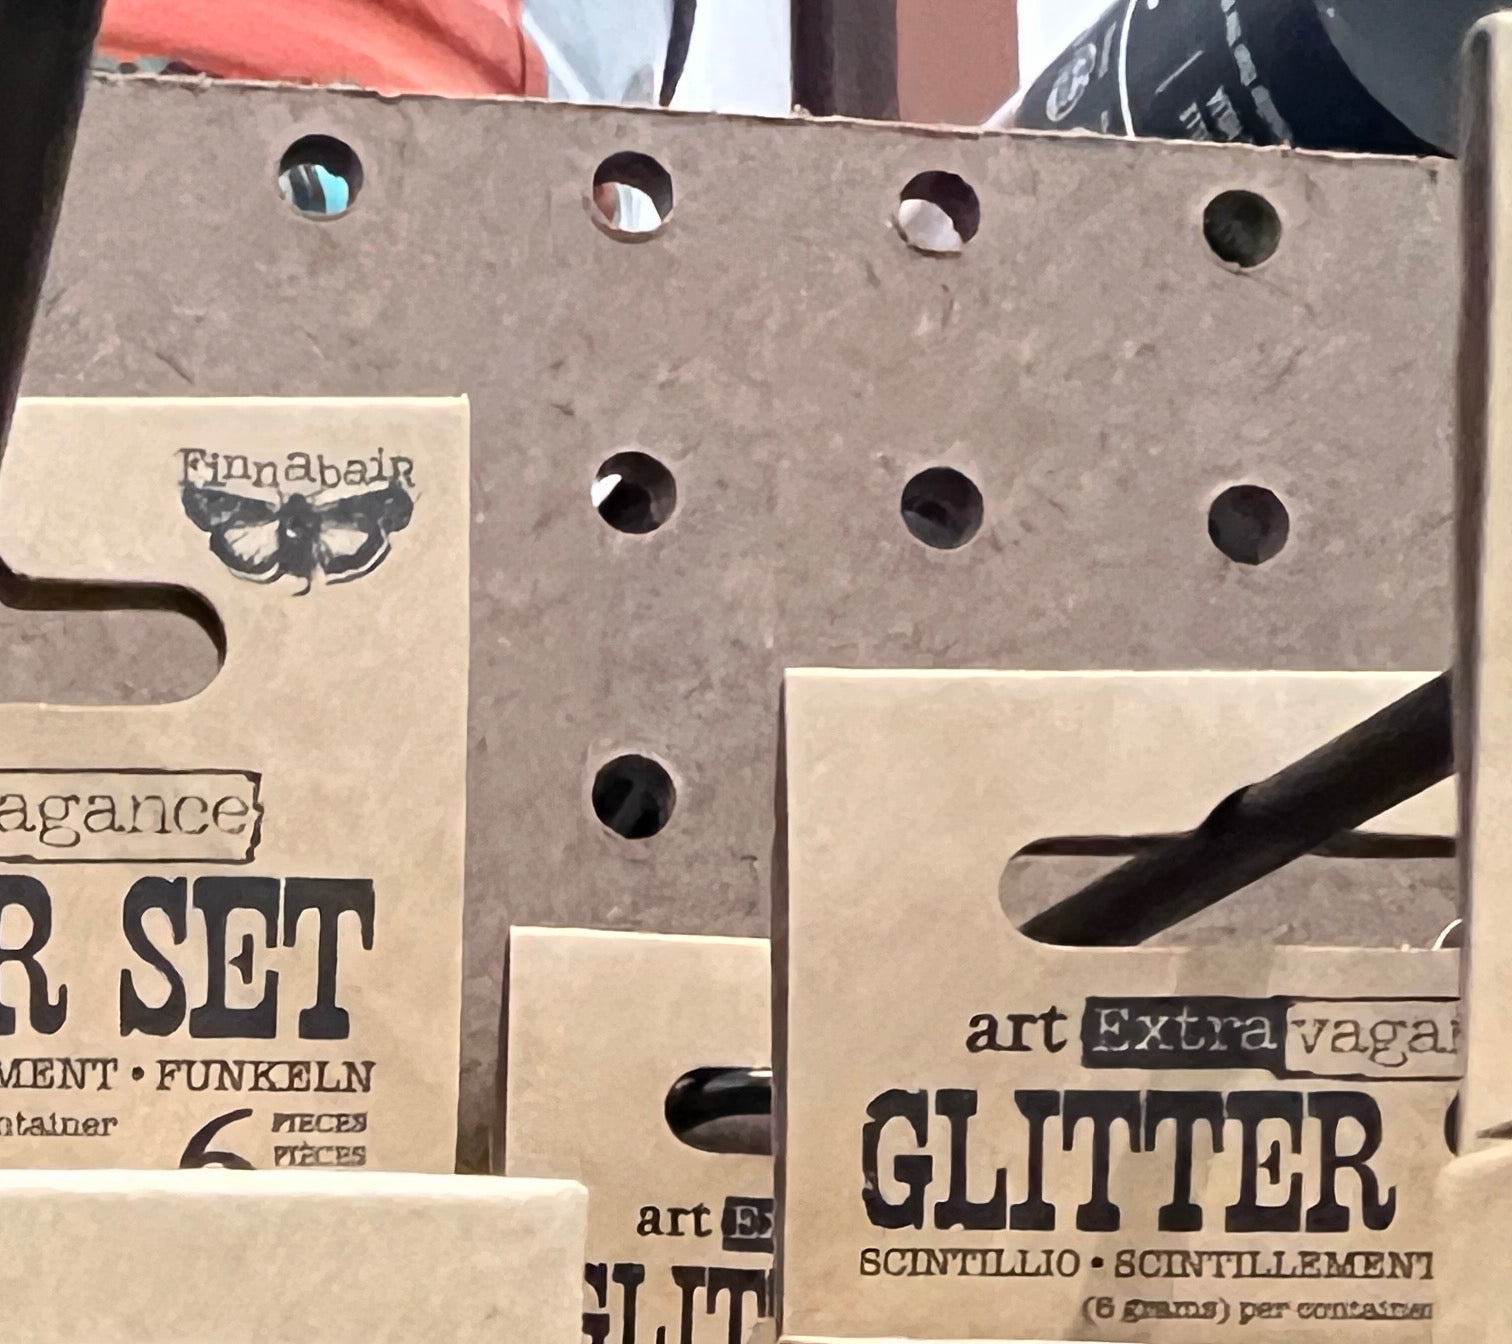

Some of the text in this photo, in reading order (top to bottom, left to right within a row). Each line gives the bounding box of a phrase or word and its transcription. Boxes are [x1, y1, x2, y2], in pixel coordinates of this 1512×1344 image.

[120, 877, 375, 1040] SET
[965, 1007, 1068, 1056] art
[155, 1059, 376, 1093] FUNKELN
[271, 1112, 369, 1133] PIECES
[861, 1088, 1397, 1233] GLITTER
[637, 1203, 713, 1238] art
[860, 1248, 1080, 1277] SCINTILLIO
